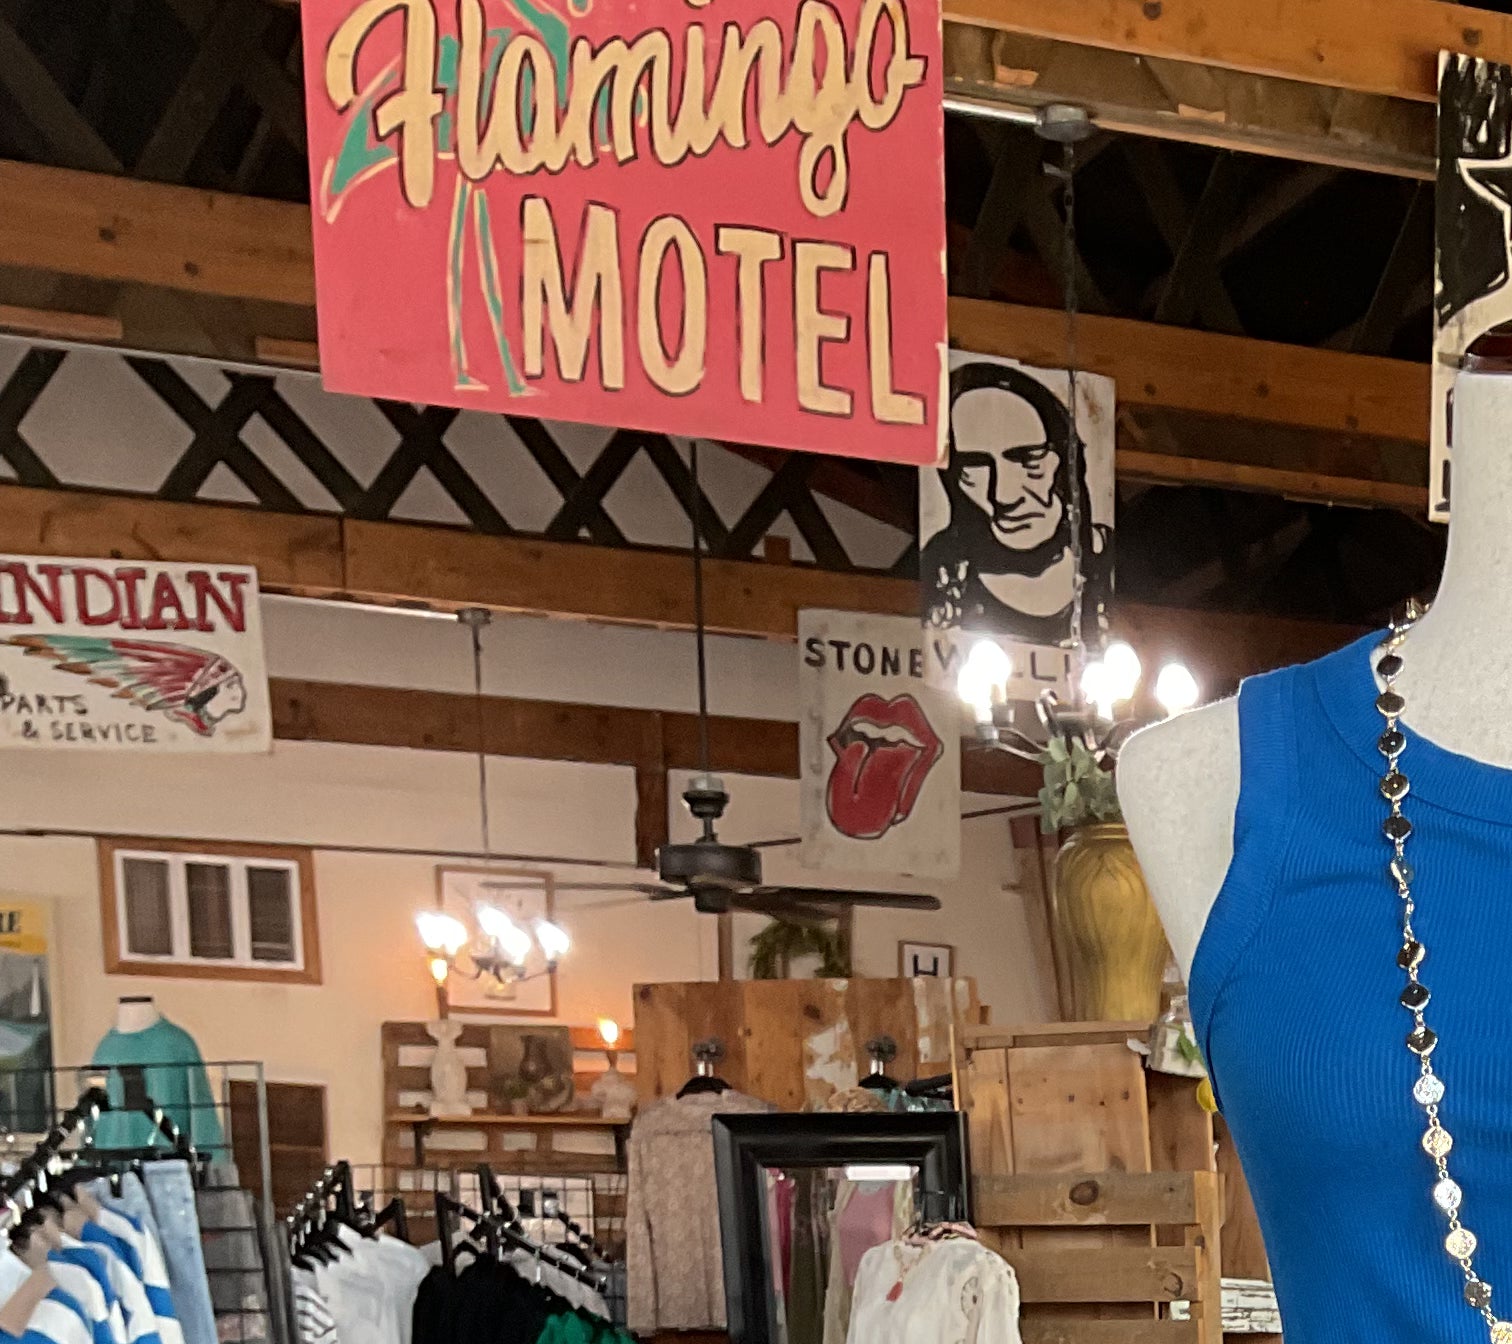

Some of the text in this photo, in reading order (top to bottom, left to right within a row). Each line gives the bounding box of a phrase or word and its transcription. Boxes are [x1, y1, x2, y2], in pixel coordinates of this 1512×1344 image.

[323, 0, 928, 217] Flamingo
[519, 193, 928, 425] MOTEL
[0, 562, 249, 632] NDIAN
[50, 720, 157, 744] SERVICE
